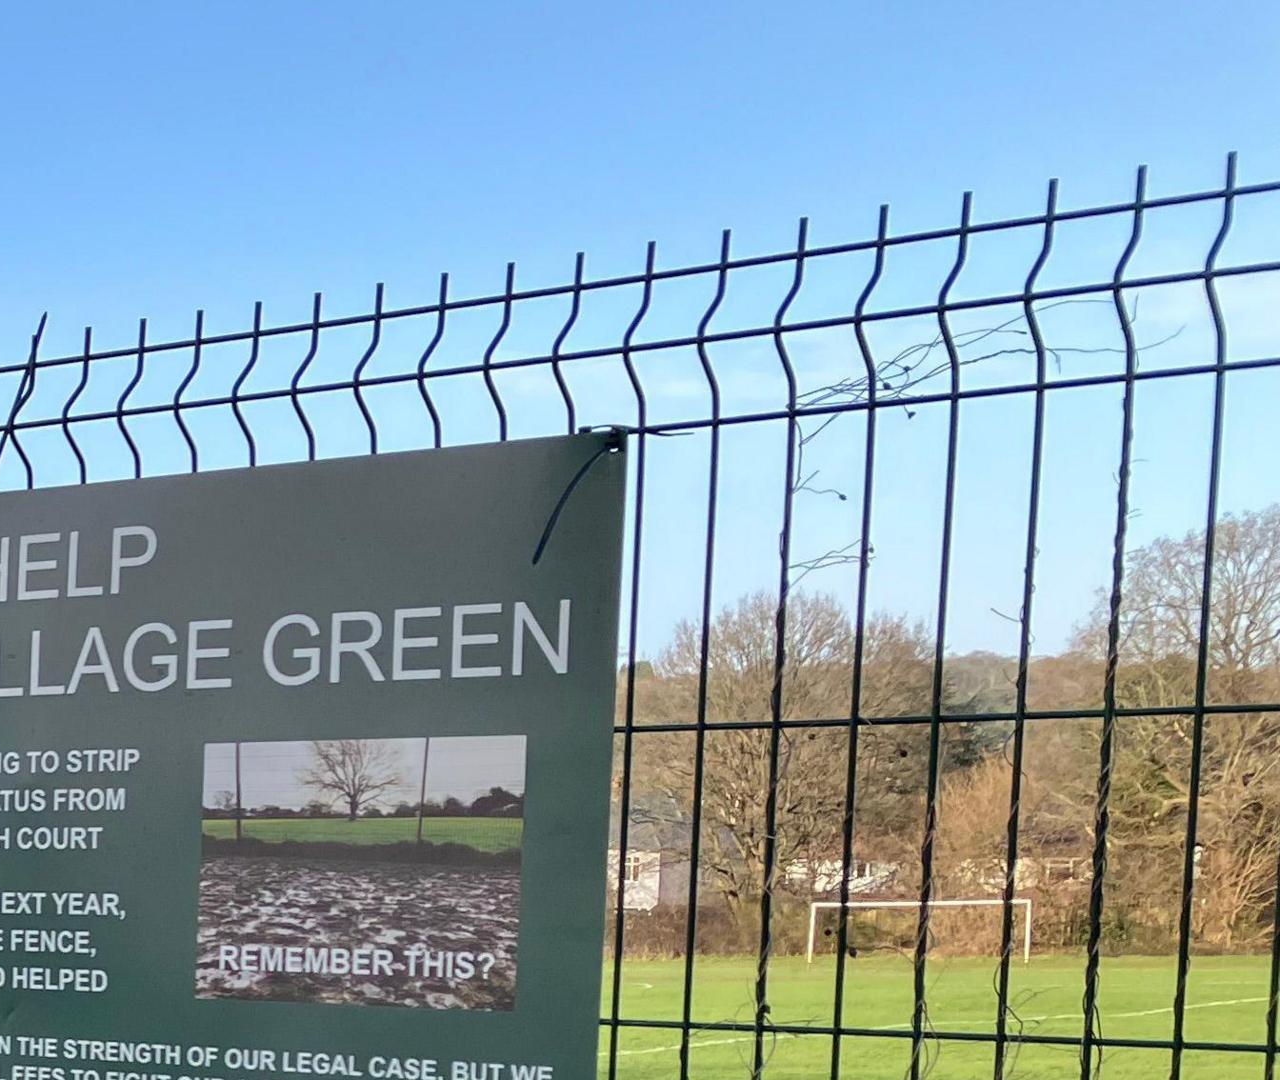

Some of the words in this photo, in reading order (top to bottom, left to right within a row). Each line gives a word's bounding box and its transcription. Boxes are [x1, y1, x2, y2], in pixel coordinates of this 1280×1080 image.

[263, 599, 571, 686] GREEN
[26, 750, 60, 774] TO
[66, 748, 140, 773] STRIP
[53, 788, 126, 812] FROM
[16, 826, 104, 850] COURT
[51, 892, 126, 920] YEAR,
[10, 929, 97, 958] FENCE,
[219, 945, 394, 976] REMEMBER
[403, 949, 496, 980] THIS?
[12, 966, 108, 993] HELPED
[16, 1036, 59, 1058] THE
[63, 1038, 181, 1066] STRENGTH
[186, 1046, 219, 1068] OF
[224, 1048, 277, 1072] OUR
[282, 1052, 363, 1077] LEGAL
